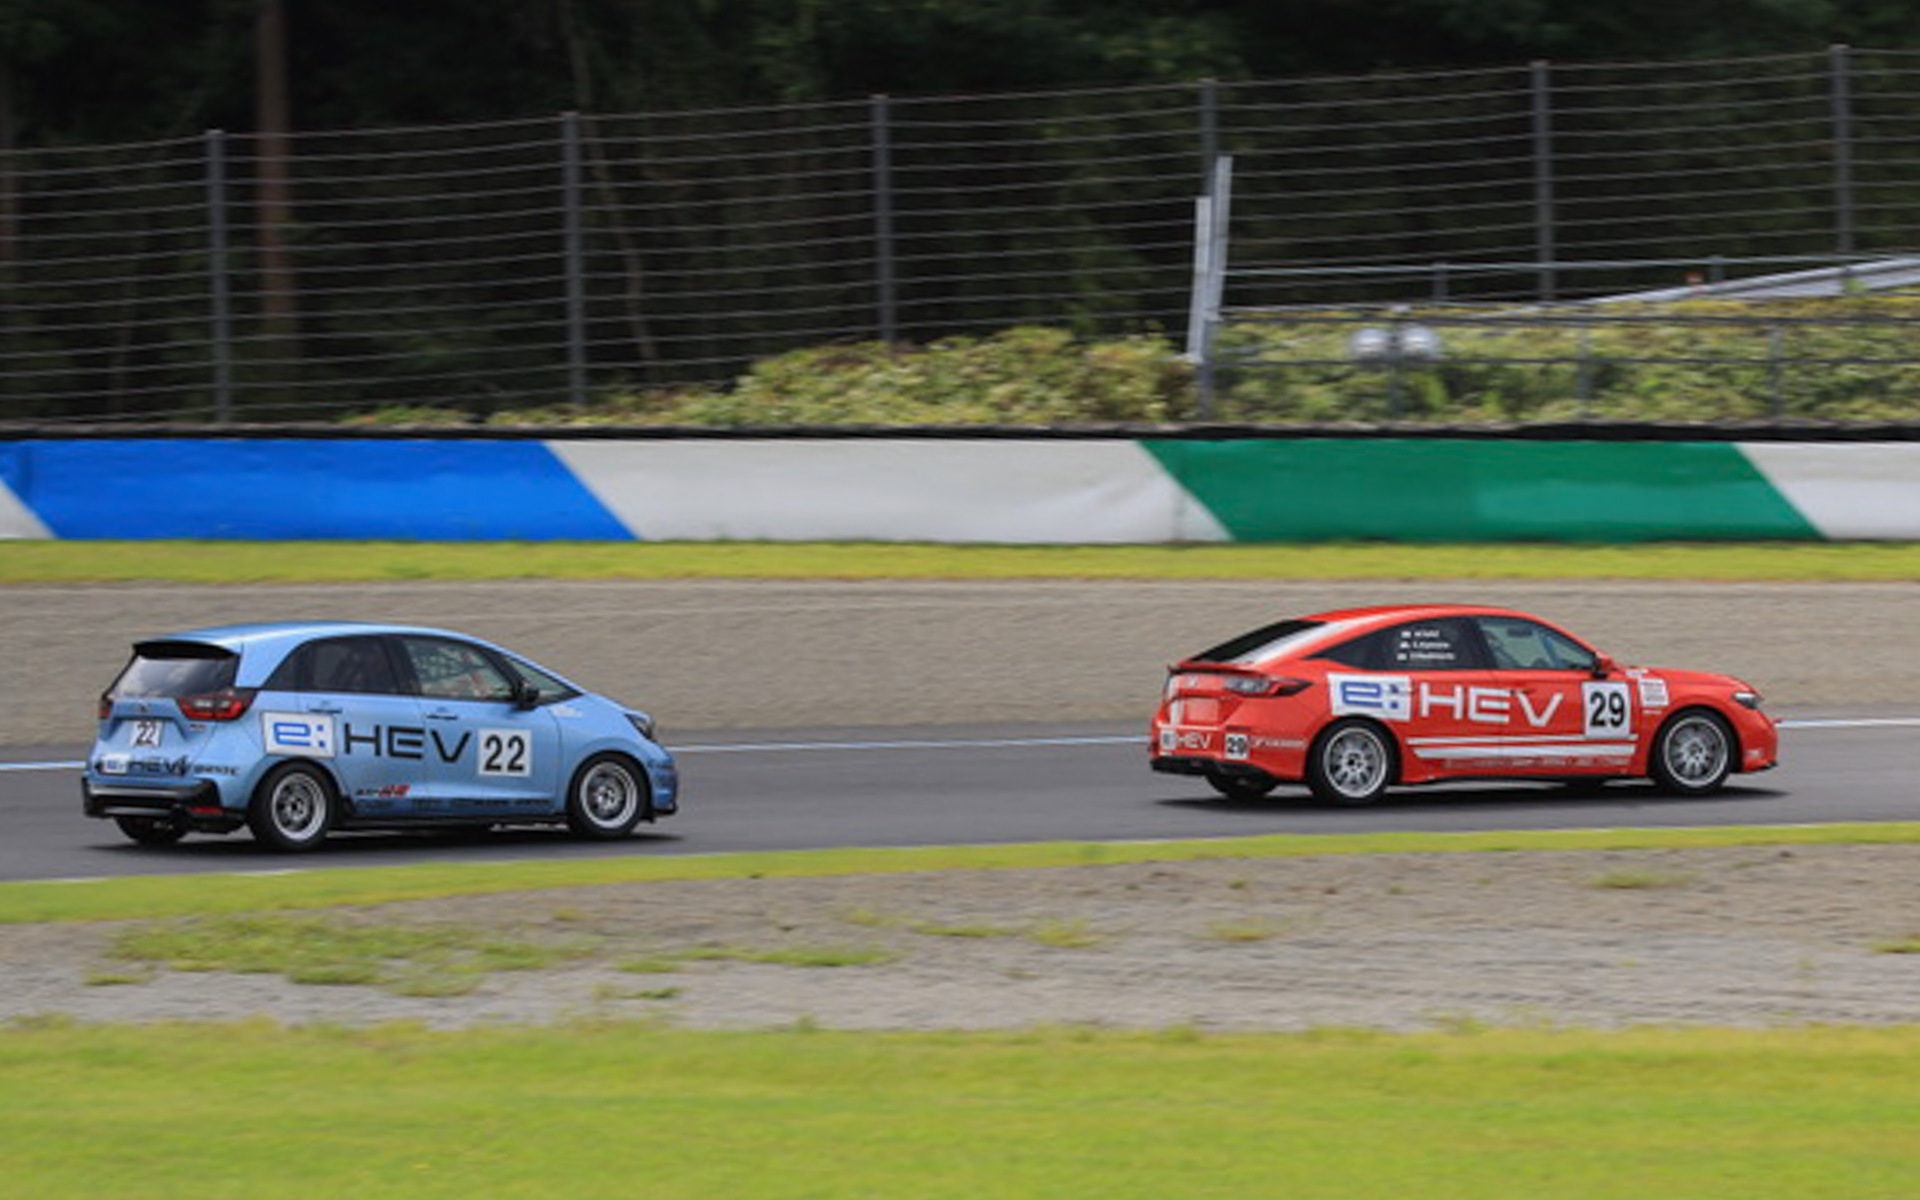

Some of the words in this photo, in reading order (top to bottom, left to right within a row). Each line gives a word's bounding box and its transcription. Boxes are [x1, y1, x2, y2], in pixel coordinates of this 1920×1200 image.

[1419, 682, 1563, 727] HEV
[1589, 691, 1625, 728] 29
[344, 722, 473, 763] HEV
[484, 734, 526, 773] 22
